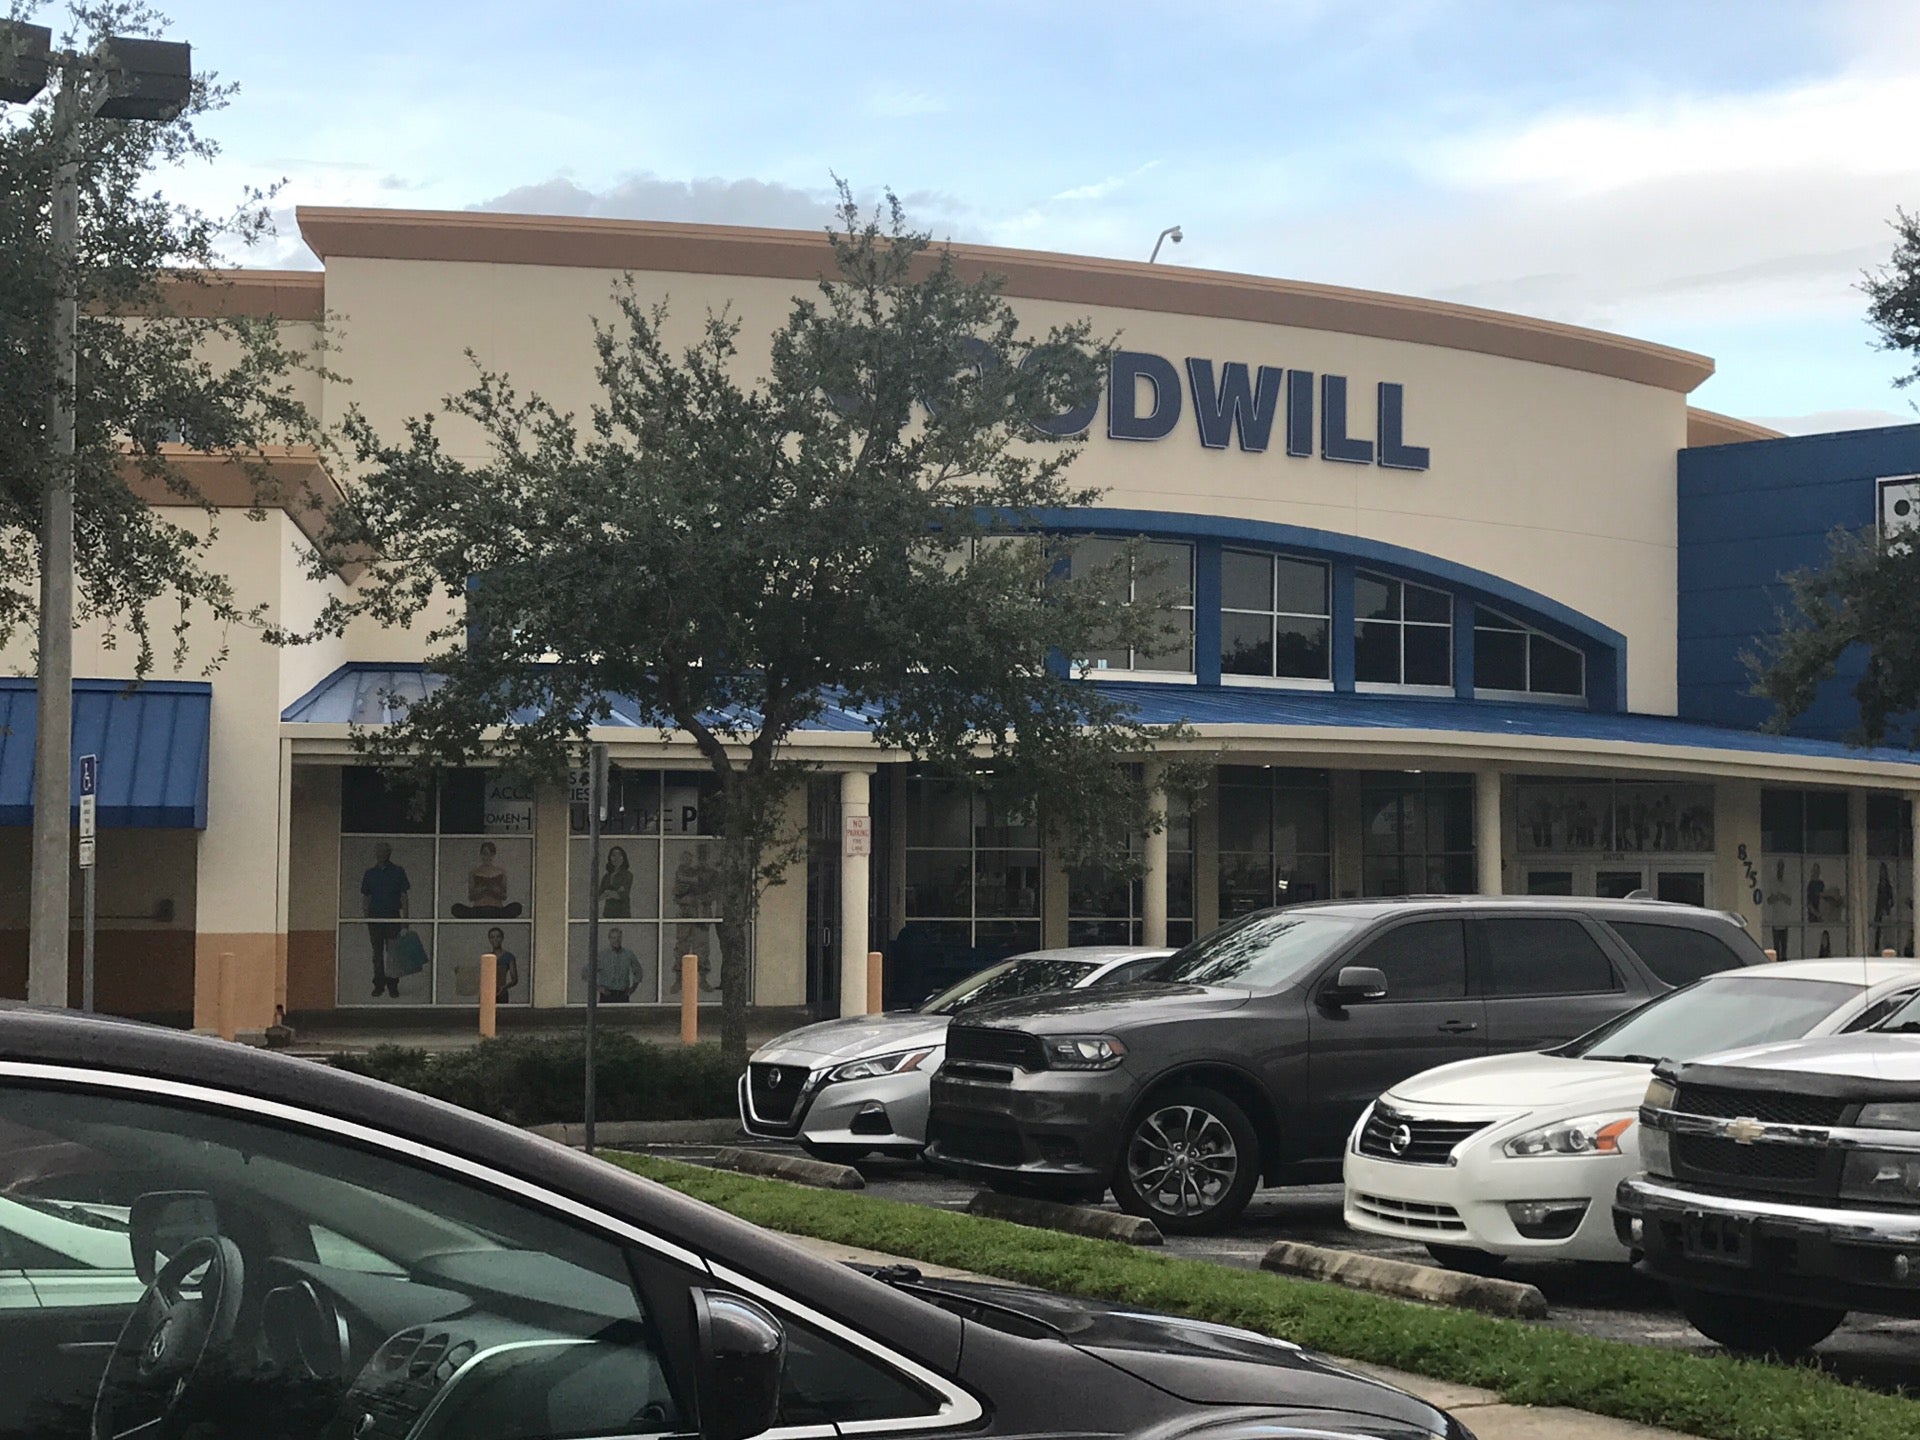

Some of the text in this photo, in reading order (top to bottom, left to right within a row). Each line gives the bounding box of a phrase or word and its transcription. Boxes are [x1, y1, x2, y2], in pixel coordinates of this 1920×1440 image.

[826, 334, 1430, 470] ODWILL
[847, 829, 869, 837] PARKING
[852, 820, 863, 828] NO
[1738, 843, 1763, 905] 8750
